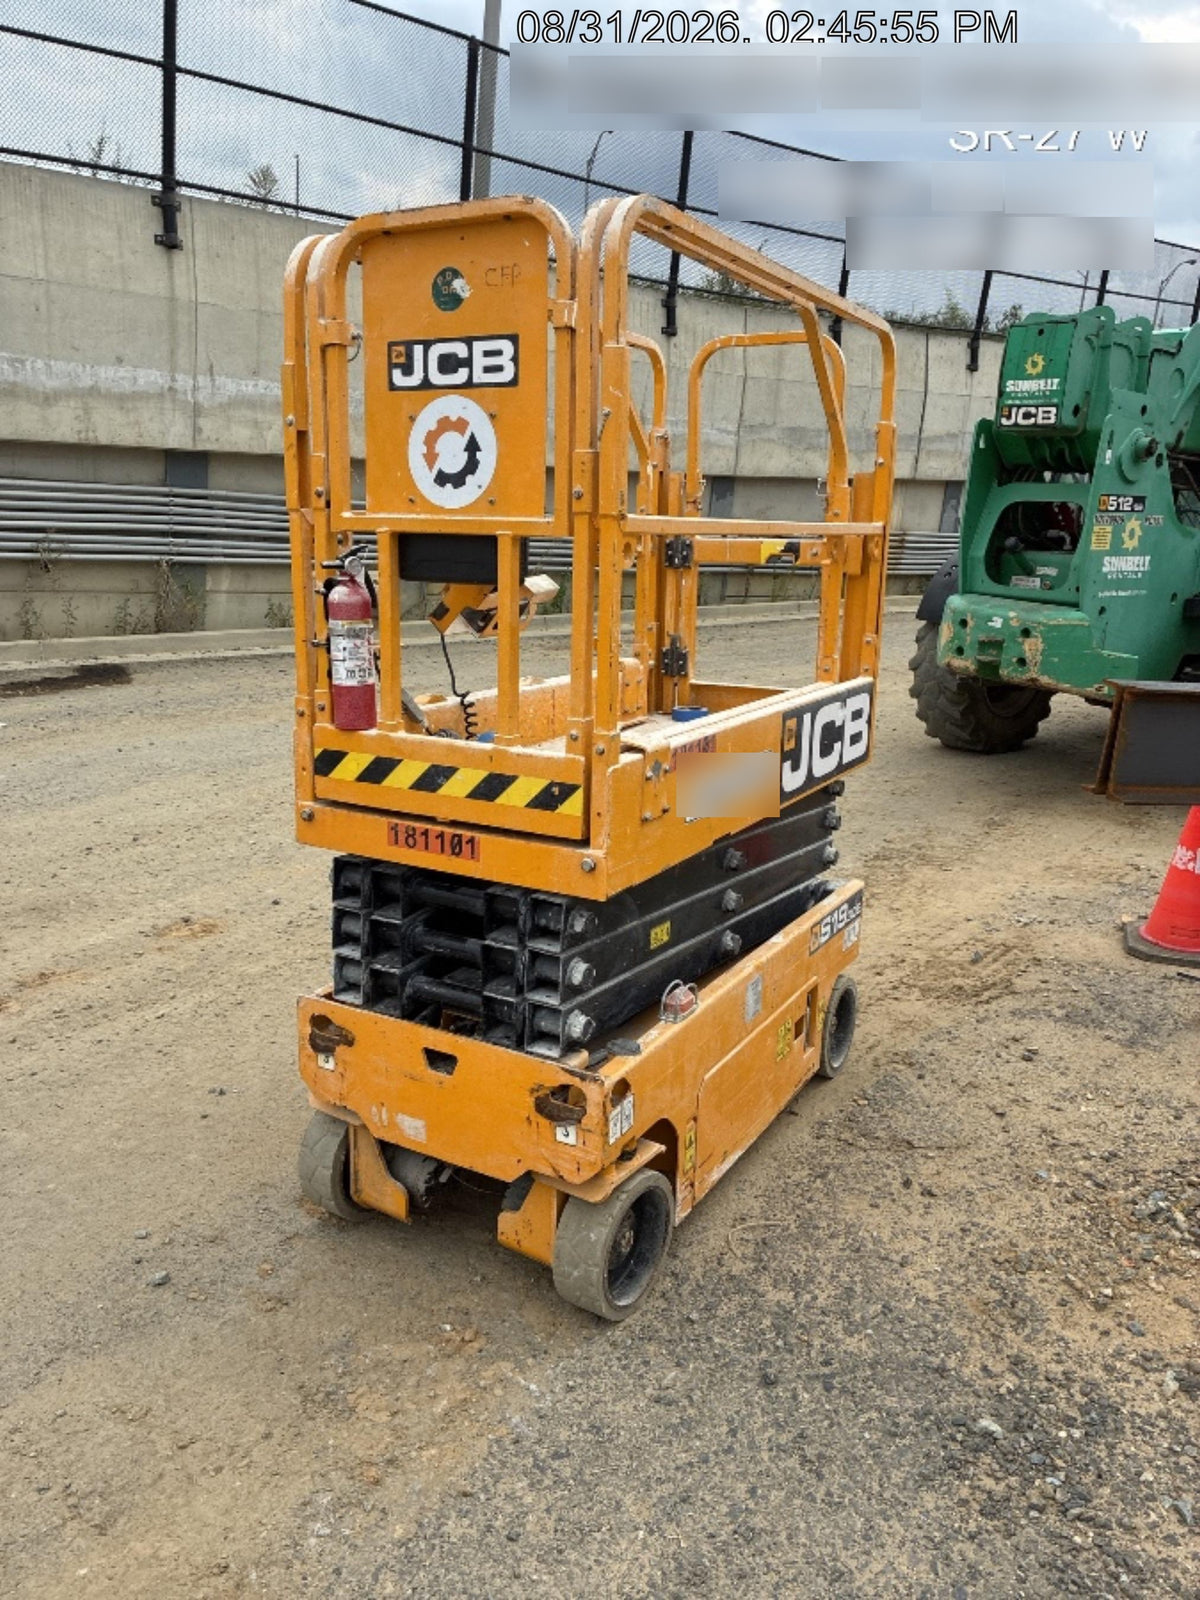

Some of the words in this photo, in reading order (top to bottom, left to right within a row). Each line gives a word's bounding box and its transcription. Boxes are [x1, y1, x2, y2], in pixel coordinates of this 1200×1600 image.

[392, 339, 516, 387] JCB
[1006, 378, 1060, 392] SUNBELT
[1001, 407, 1057, 425] JCB
[1102, 556, 1152, 573] SUNBELT
[782, 693, 870, 792] JCB
[390, 823, 476, 859] 181101
